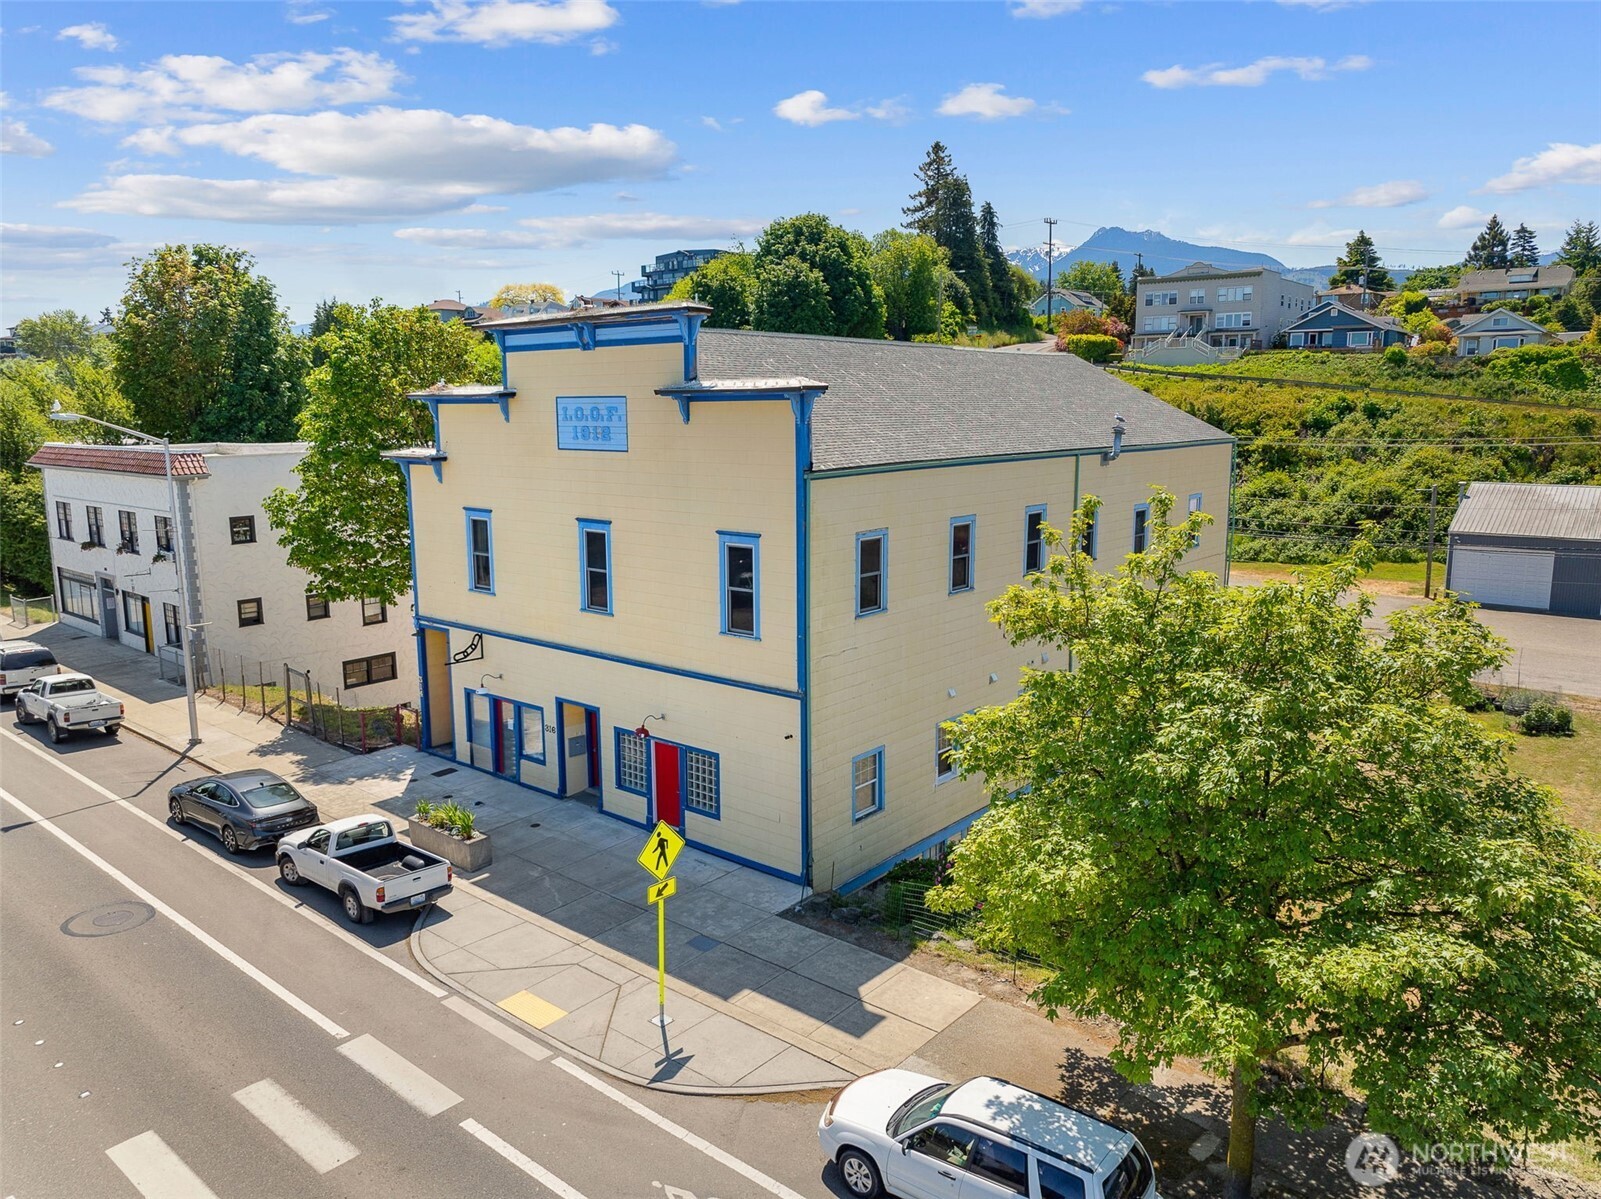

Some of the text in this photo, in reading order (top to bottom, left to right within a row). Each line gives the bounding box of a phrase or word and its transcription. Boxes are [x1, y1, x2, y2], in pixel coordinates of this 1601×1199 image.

[562, 406, 622, 422] I.O.O.F.
[572, 426, 611, 441] 1912
[544, 724, 557, 734] 316
